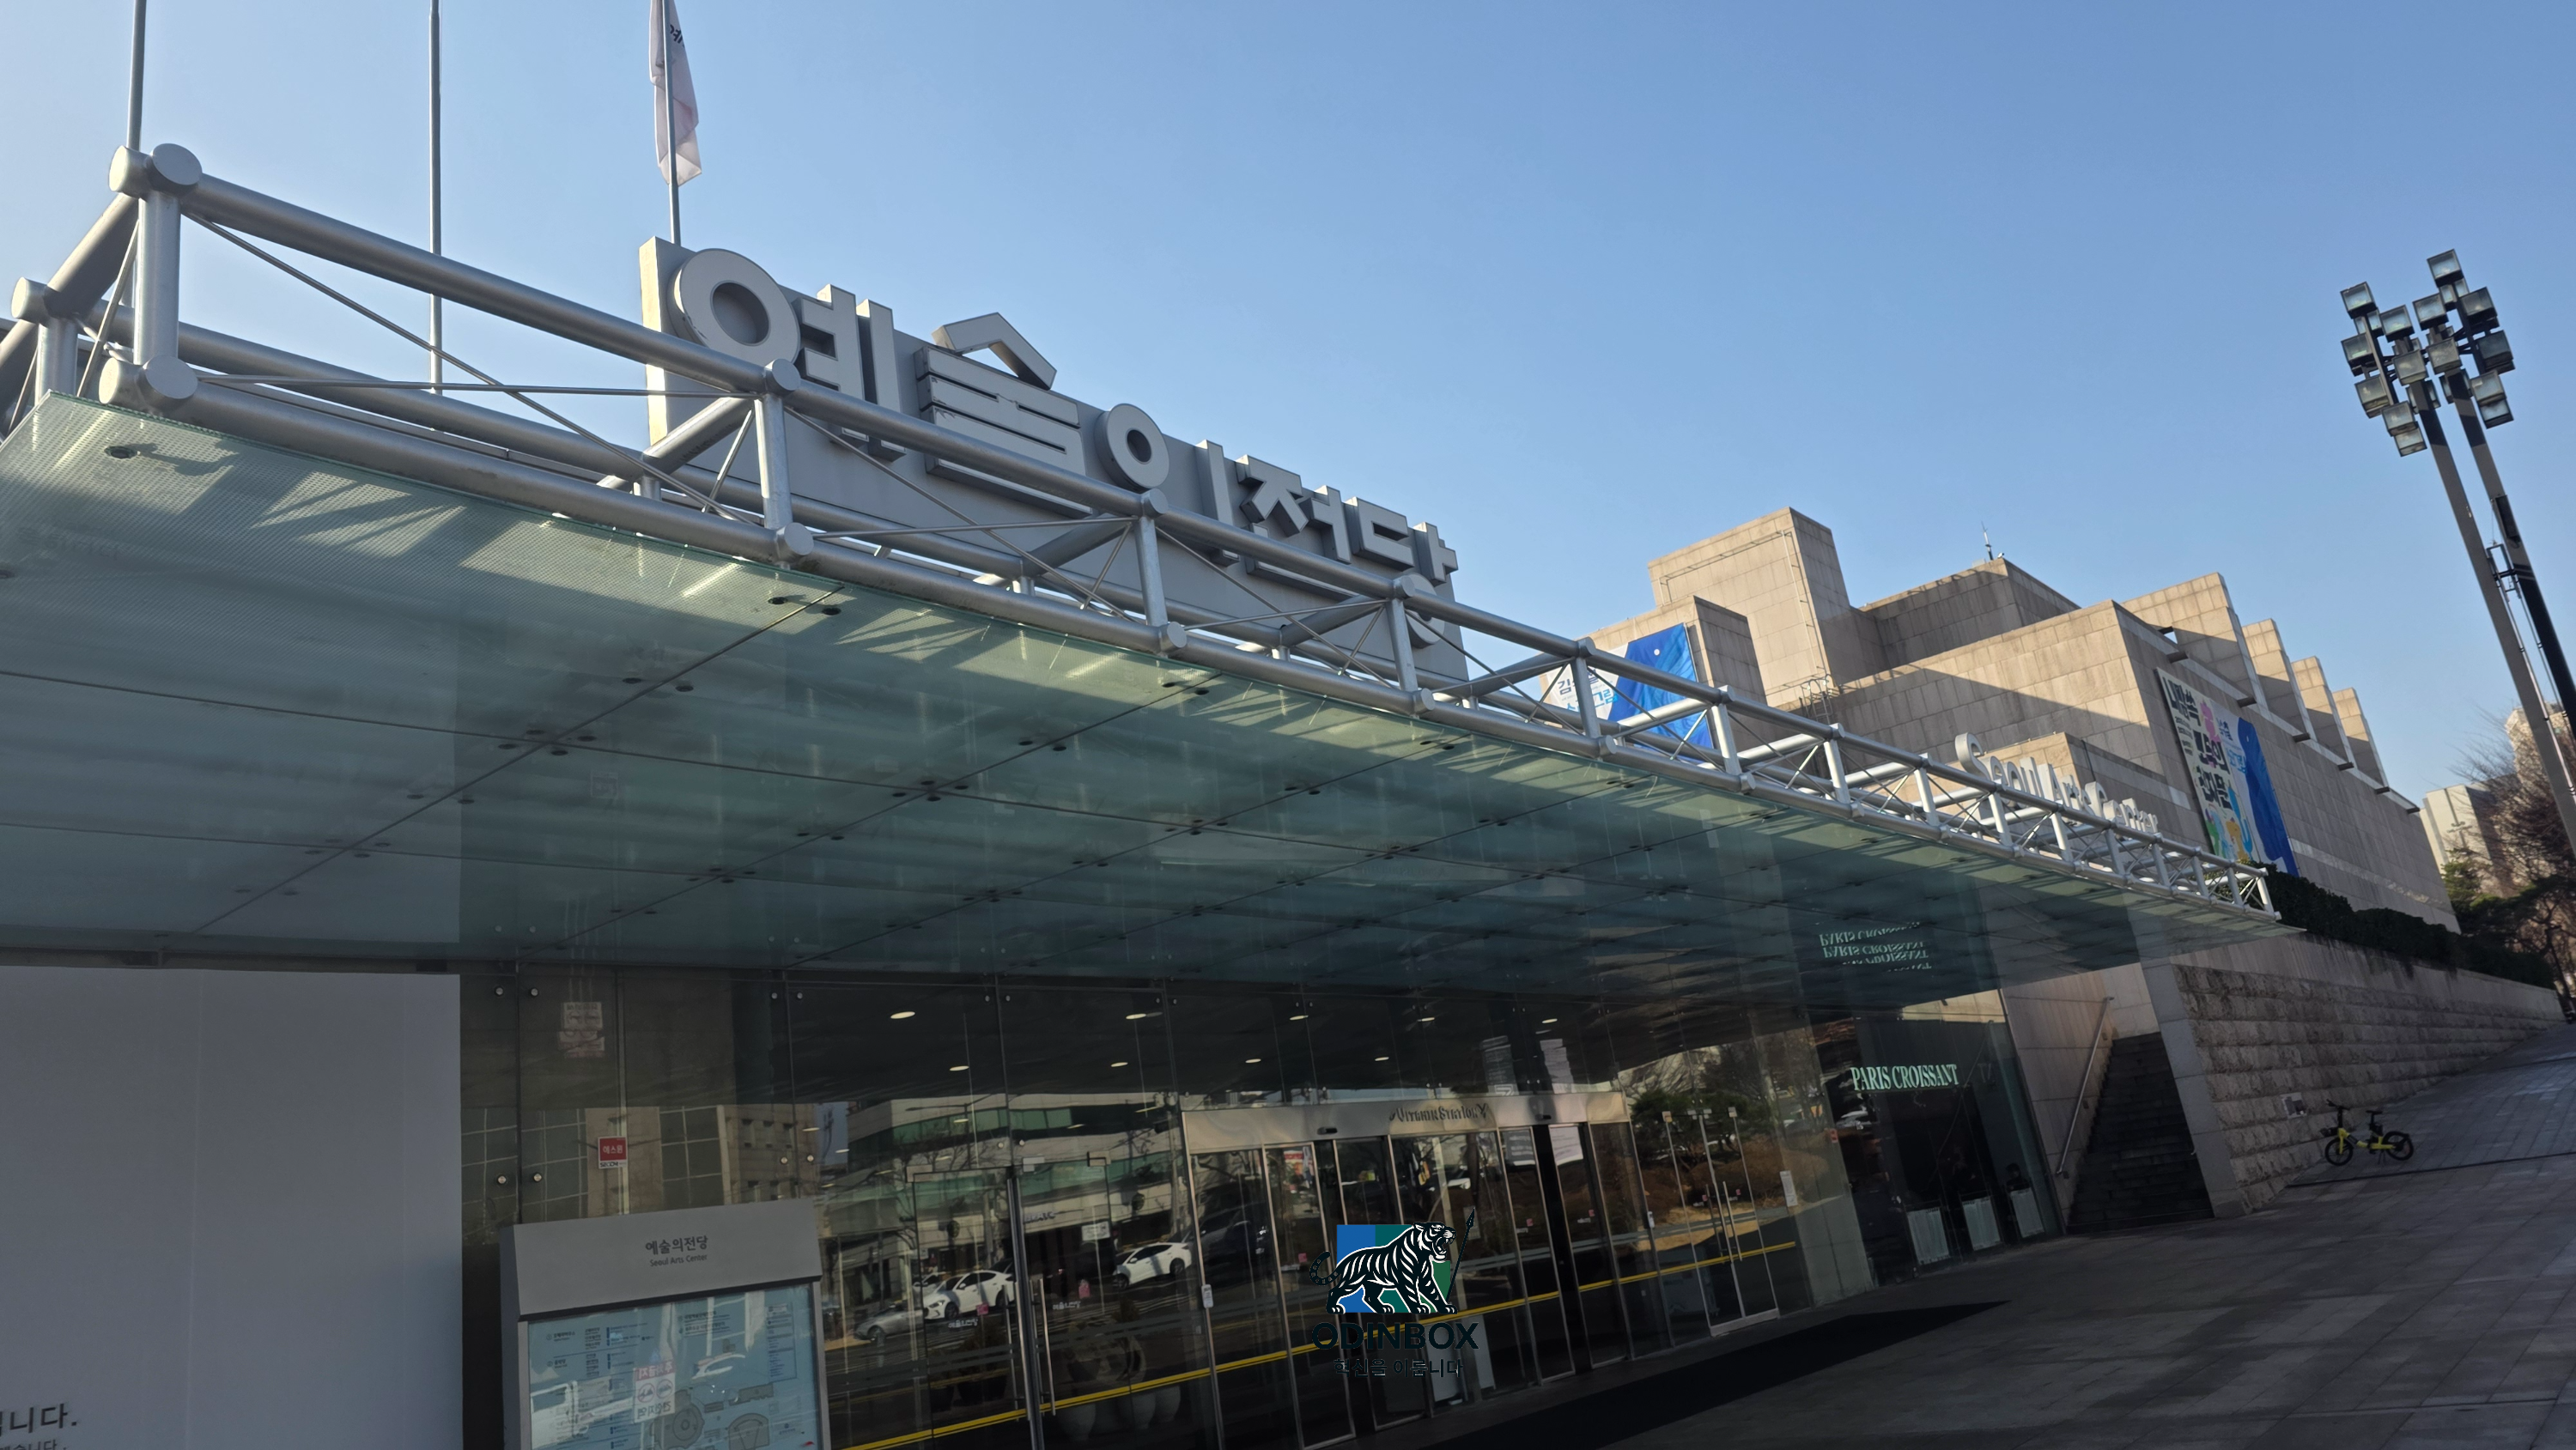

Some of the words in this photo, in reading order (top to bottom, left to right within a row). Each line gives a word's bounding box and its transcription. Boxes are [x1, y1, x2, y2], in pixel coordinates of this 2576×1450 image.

[671, 249, 1458, 646] 예술의전당
[1955, 732, 2045, 820] Seoul
[1850, 1066, 1893, 1090] PARIS
[1892, 1064, 1959, 1089] CROISSANT
[645, 1235, 708, 1255] 예술의전당
[649, 1257, 669, 1267] Seoul
[670, 1256, 684, 1265] Arts
[686, 1254, 708, 1263] Center
[0, 1403, 77, 1436] 니다.
